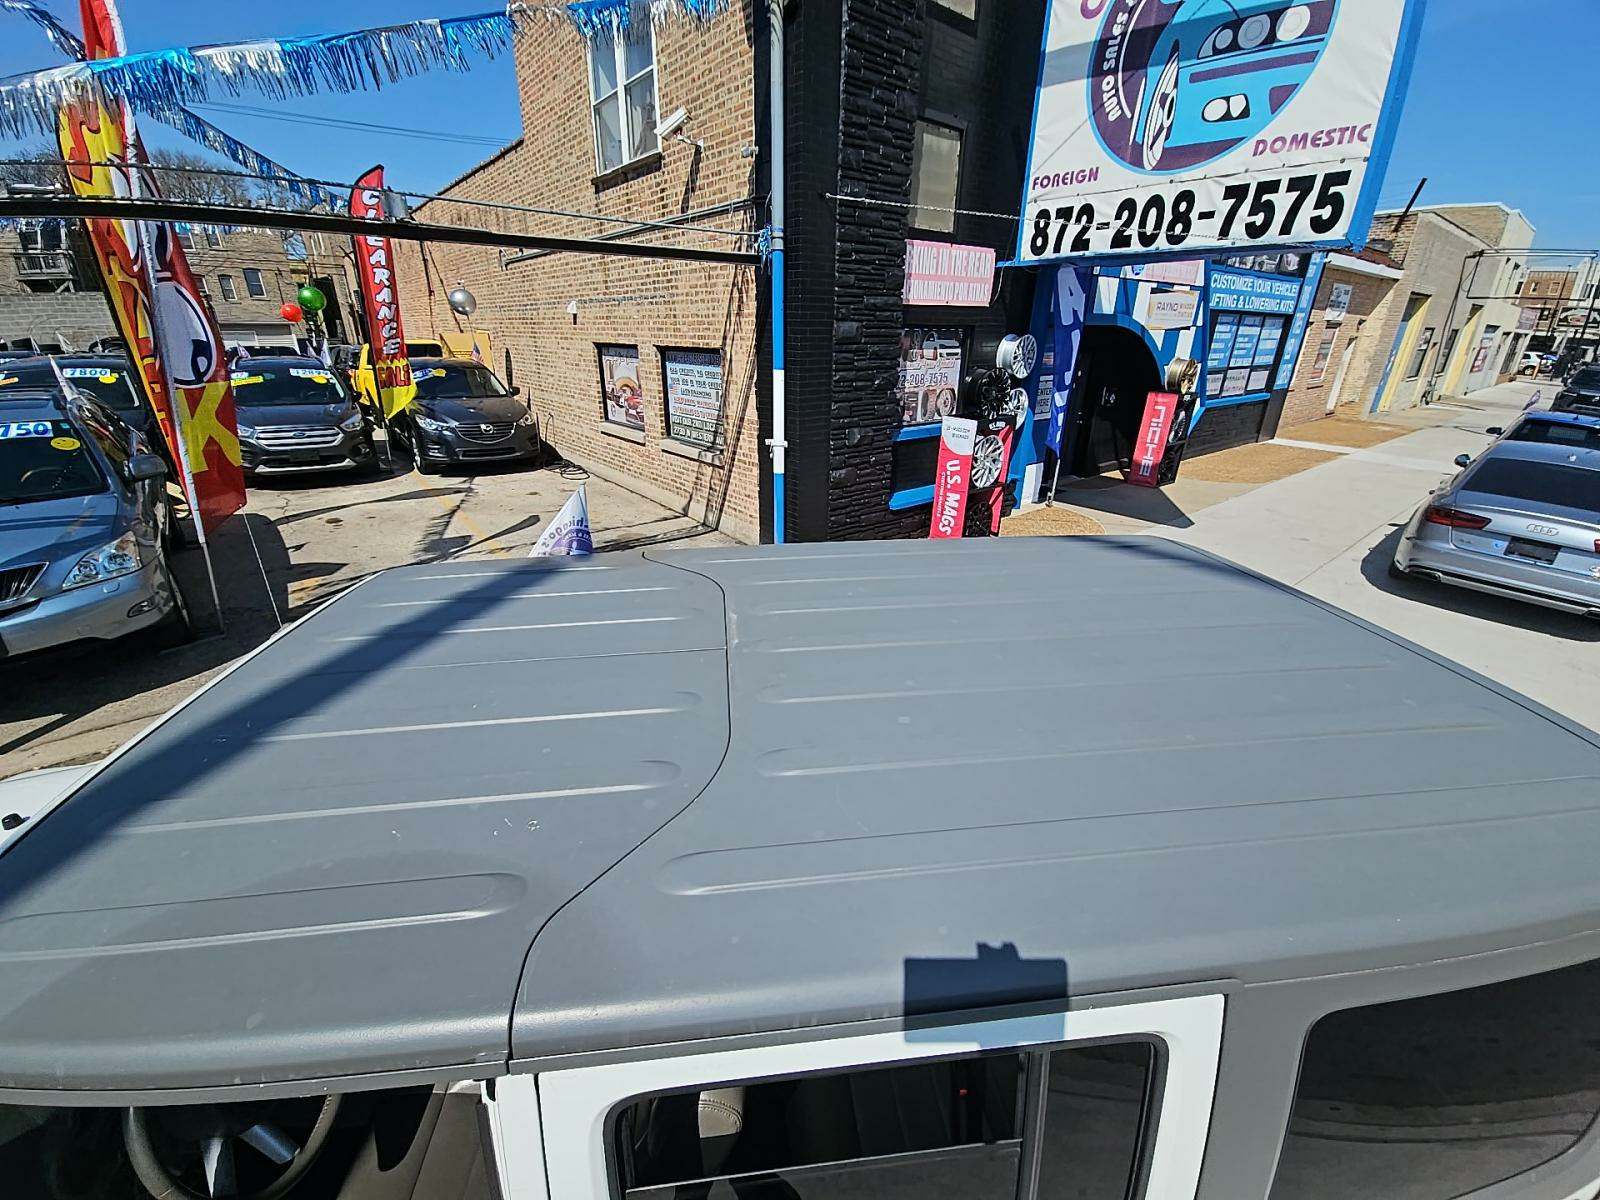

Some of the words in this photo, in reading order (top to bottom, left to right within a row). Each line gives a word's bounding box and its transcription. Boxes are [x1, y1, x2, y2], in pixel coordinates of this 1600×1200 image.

[1103, 12, 1129, 71] SALES
[1102, 75, 1122, 122] AUTO
[1252, 124, 1373, 158] DOMESTIC
[1032, 167, 1100, 191] FOREIGN
[1029, 170, 1353, 258] 872-208-7575
[1210, 273, 1253, 291] CUSTOMIZE
[1253, 279, 1272, 293] YOUR
[1237, 296, 1245, 308] &
[1245, 296, 1280, 311] LOWERING
[1279, 299, 1296, 313] KITS
[899, 371, 949, 387] 2-208-7575
[176, 381, 242, 473] K
[946, 459, 962, 489] U.S.
[938, 492, 961, 536] MAGS
